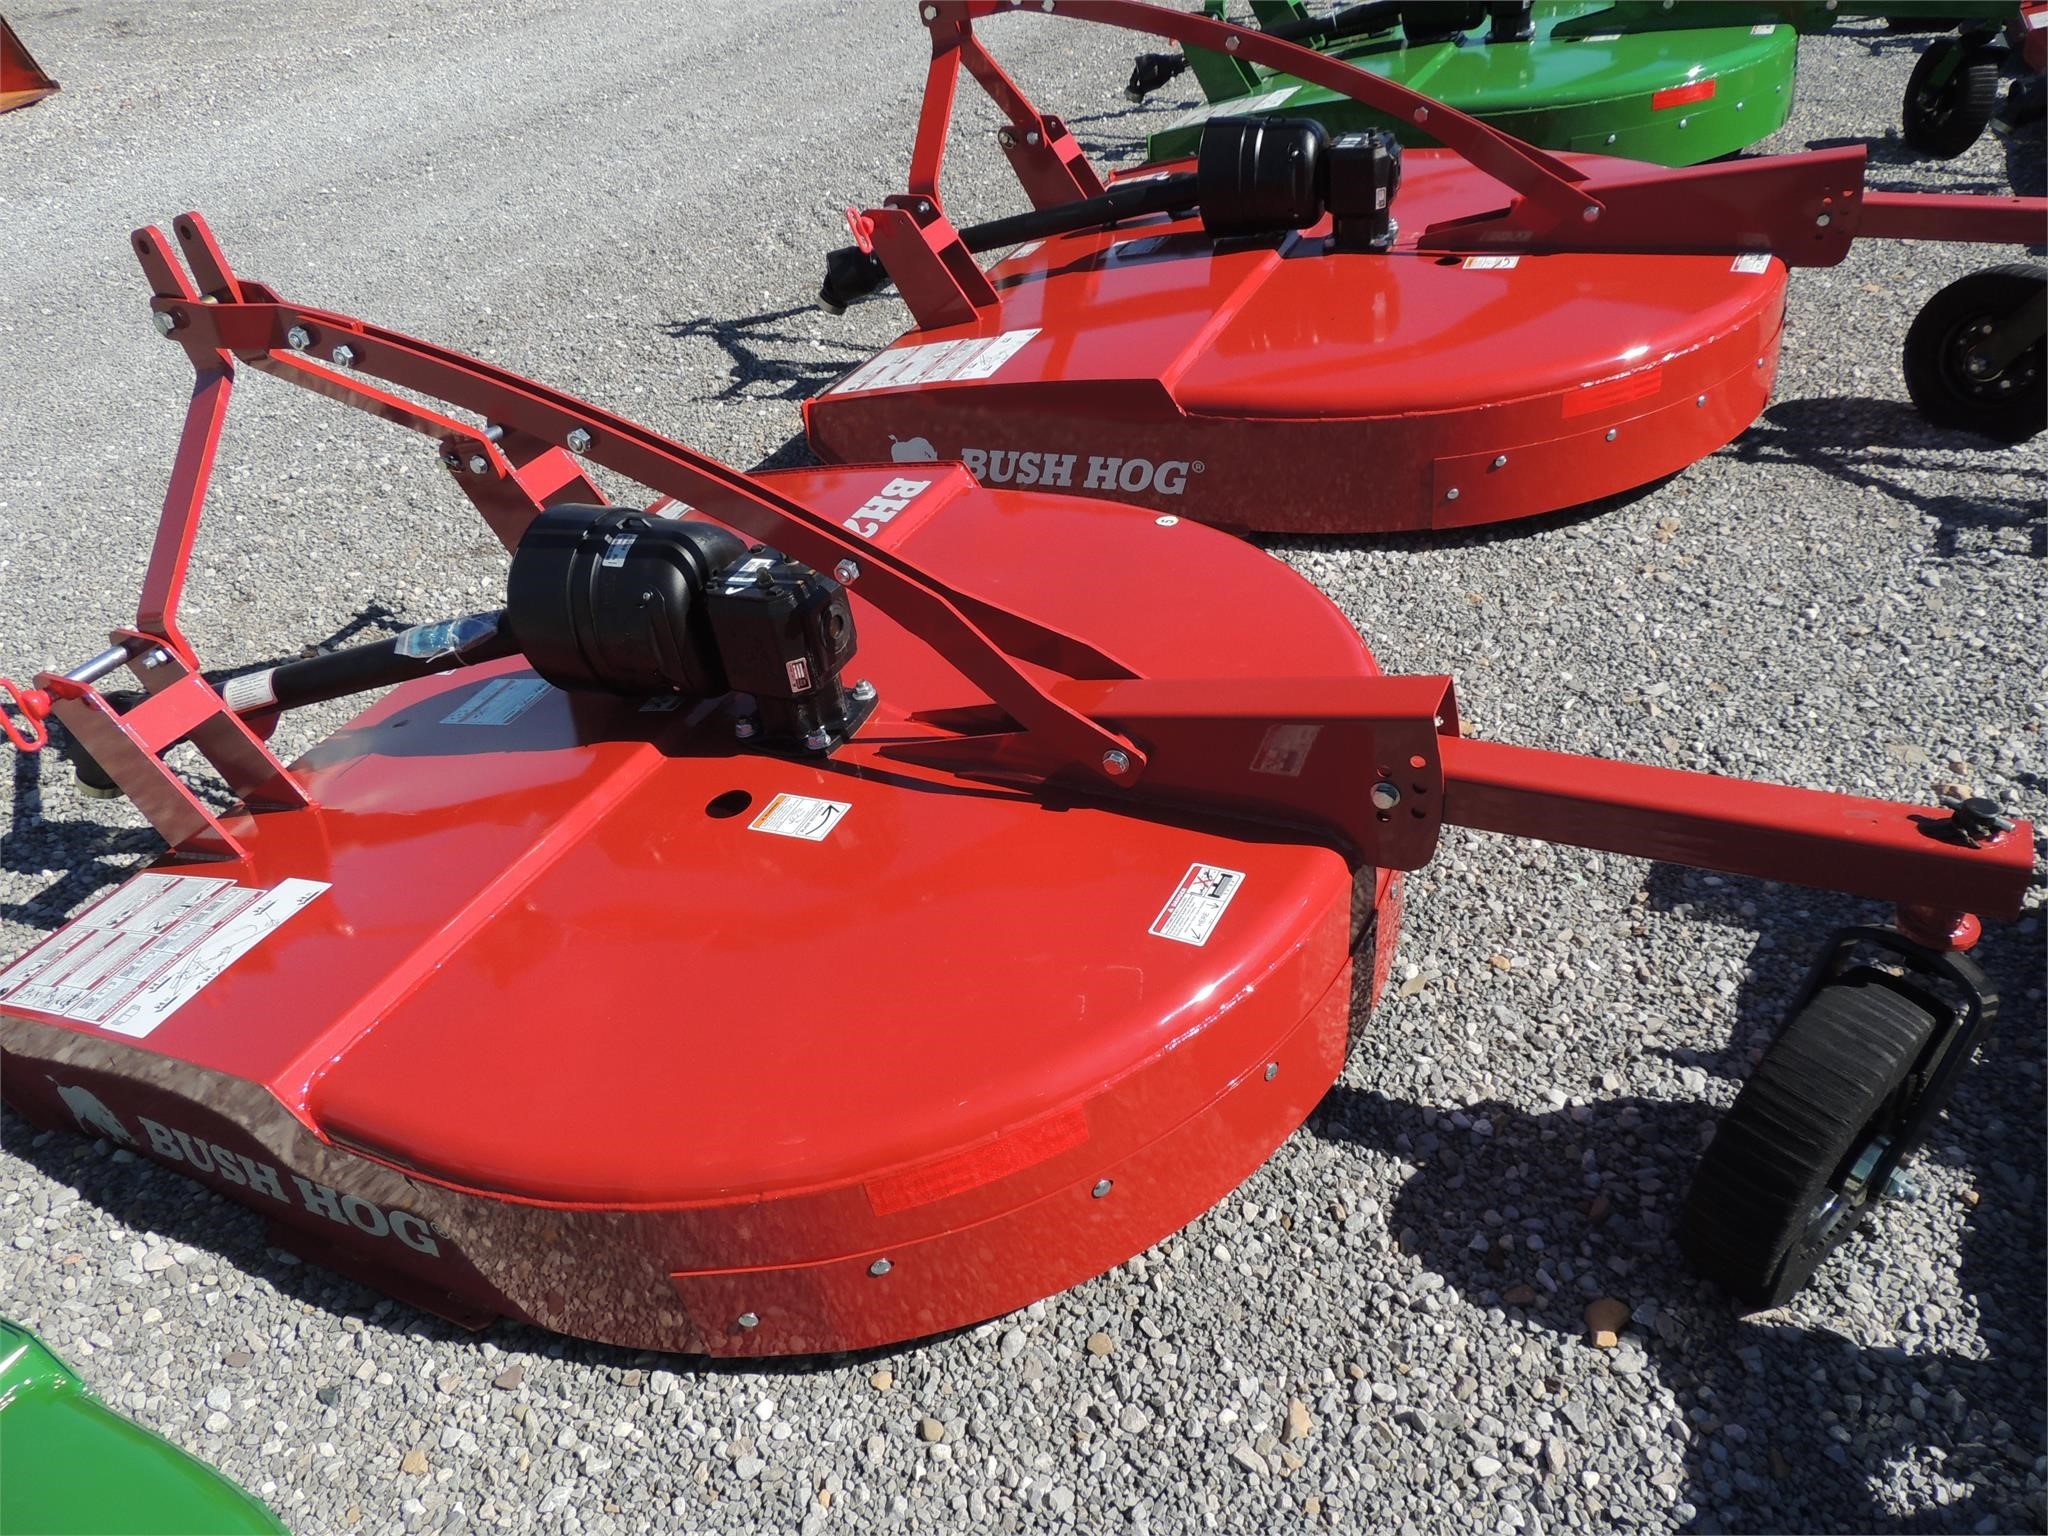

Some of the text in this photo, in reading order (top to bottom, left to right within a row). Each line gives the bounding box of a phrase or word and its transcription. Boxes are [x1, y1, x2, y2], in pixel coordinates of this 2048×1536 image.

[960, 448, 1077, 487] BUSH
[843, 478, 931, 538] BH2
[136, 1116, 291, 1204] BUSH
